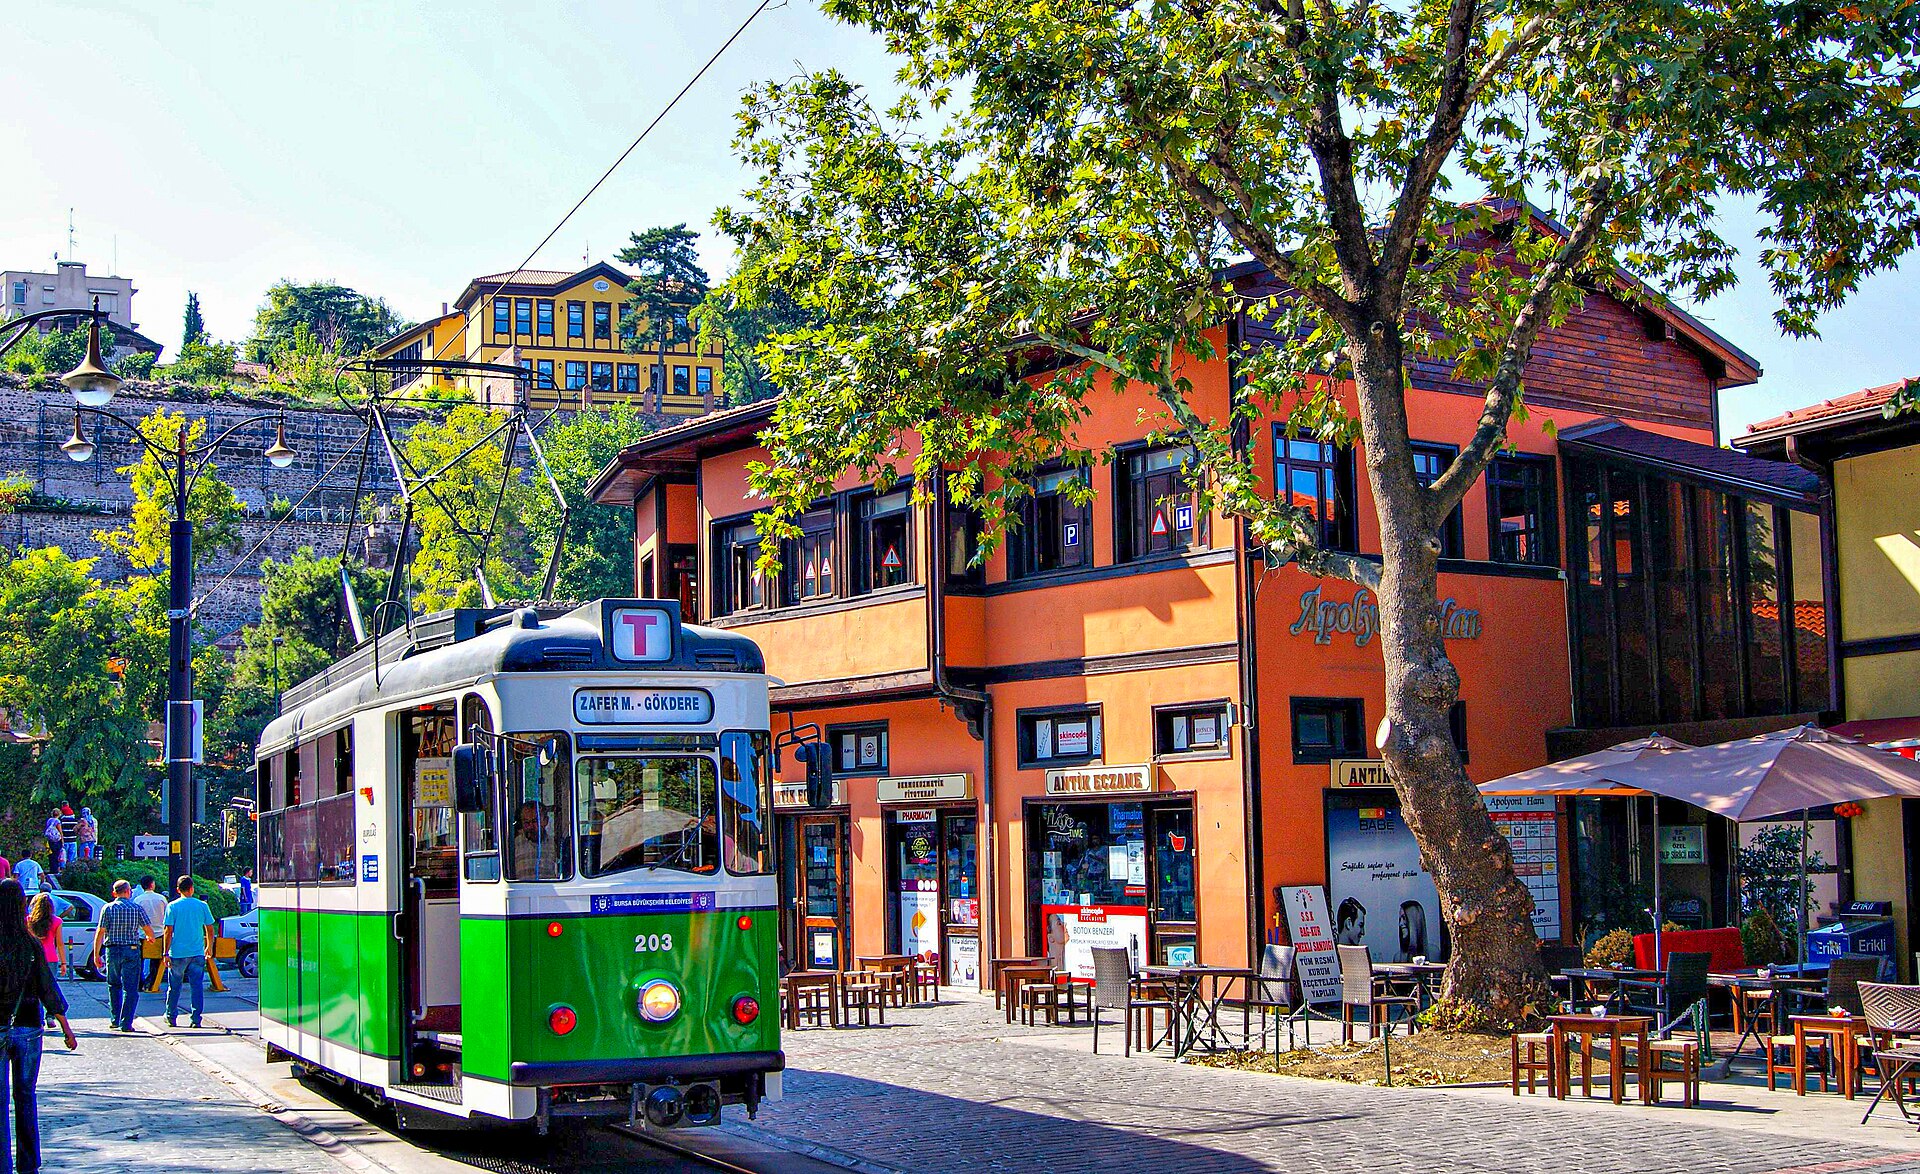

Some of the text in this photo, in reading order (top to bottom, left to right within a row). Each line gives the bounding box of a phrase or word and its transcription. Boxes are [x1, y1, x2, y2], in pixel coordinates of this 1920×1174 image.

[1179, 509, 1190, 528] H
[1067, 526, 1076, 544] P
[622, 614, 658, 656] T
[580, 696, 619, 711] ZAFER
[621, 696, 635, 711] M.
[644, 693, 700, 711] GÖKDERE
[1053, 772, 1143, 791] ANTİK ECZANE
[1489, 796, 1522, 809] Apolyont
[902, 811, 932, 820] PHARMACY
[632, 898, 665, 907] BÜYÜKŞEHİR
[665, 897, 693, 905] BELEDİYESİ
[1850, 902, 1875, 910] Erikli
[1073, 926, 1114, 935] BOTOX BENZERİ
[634, 933, 673, 952] 203
[1858, 939, 1886, 952] Erikli
[1174, 953, 1187, 961] SGK
[1299, 954, 1335, 966] TÜM RESMİ
[1308, 967, 1331, 976] KURUM
[1311, 988, 1337, 998] YAPILIR
